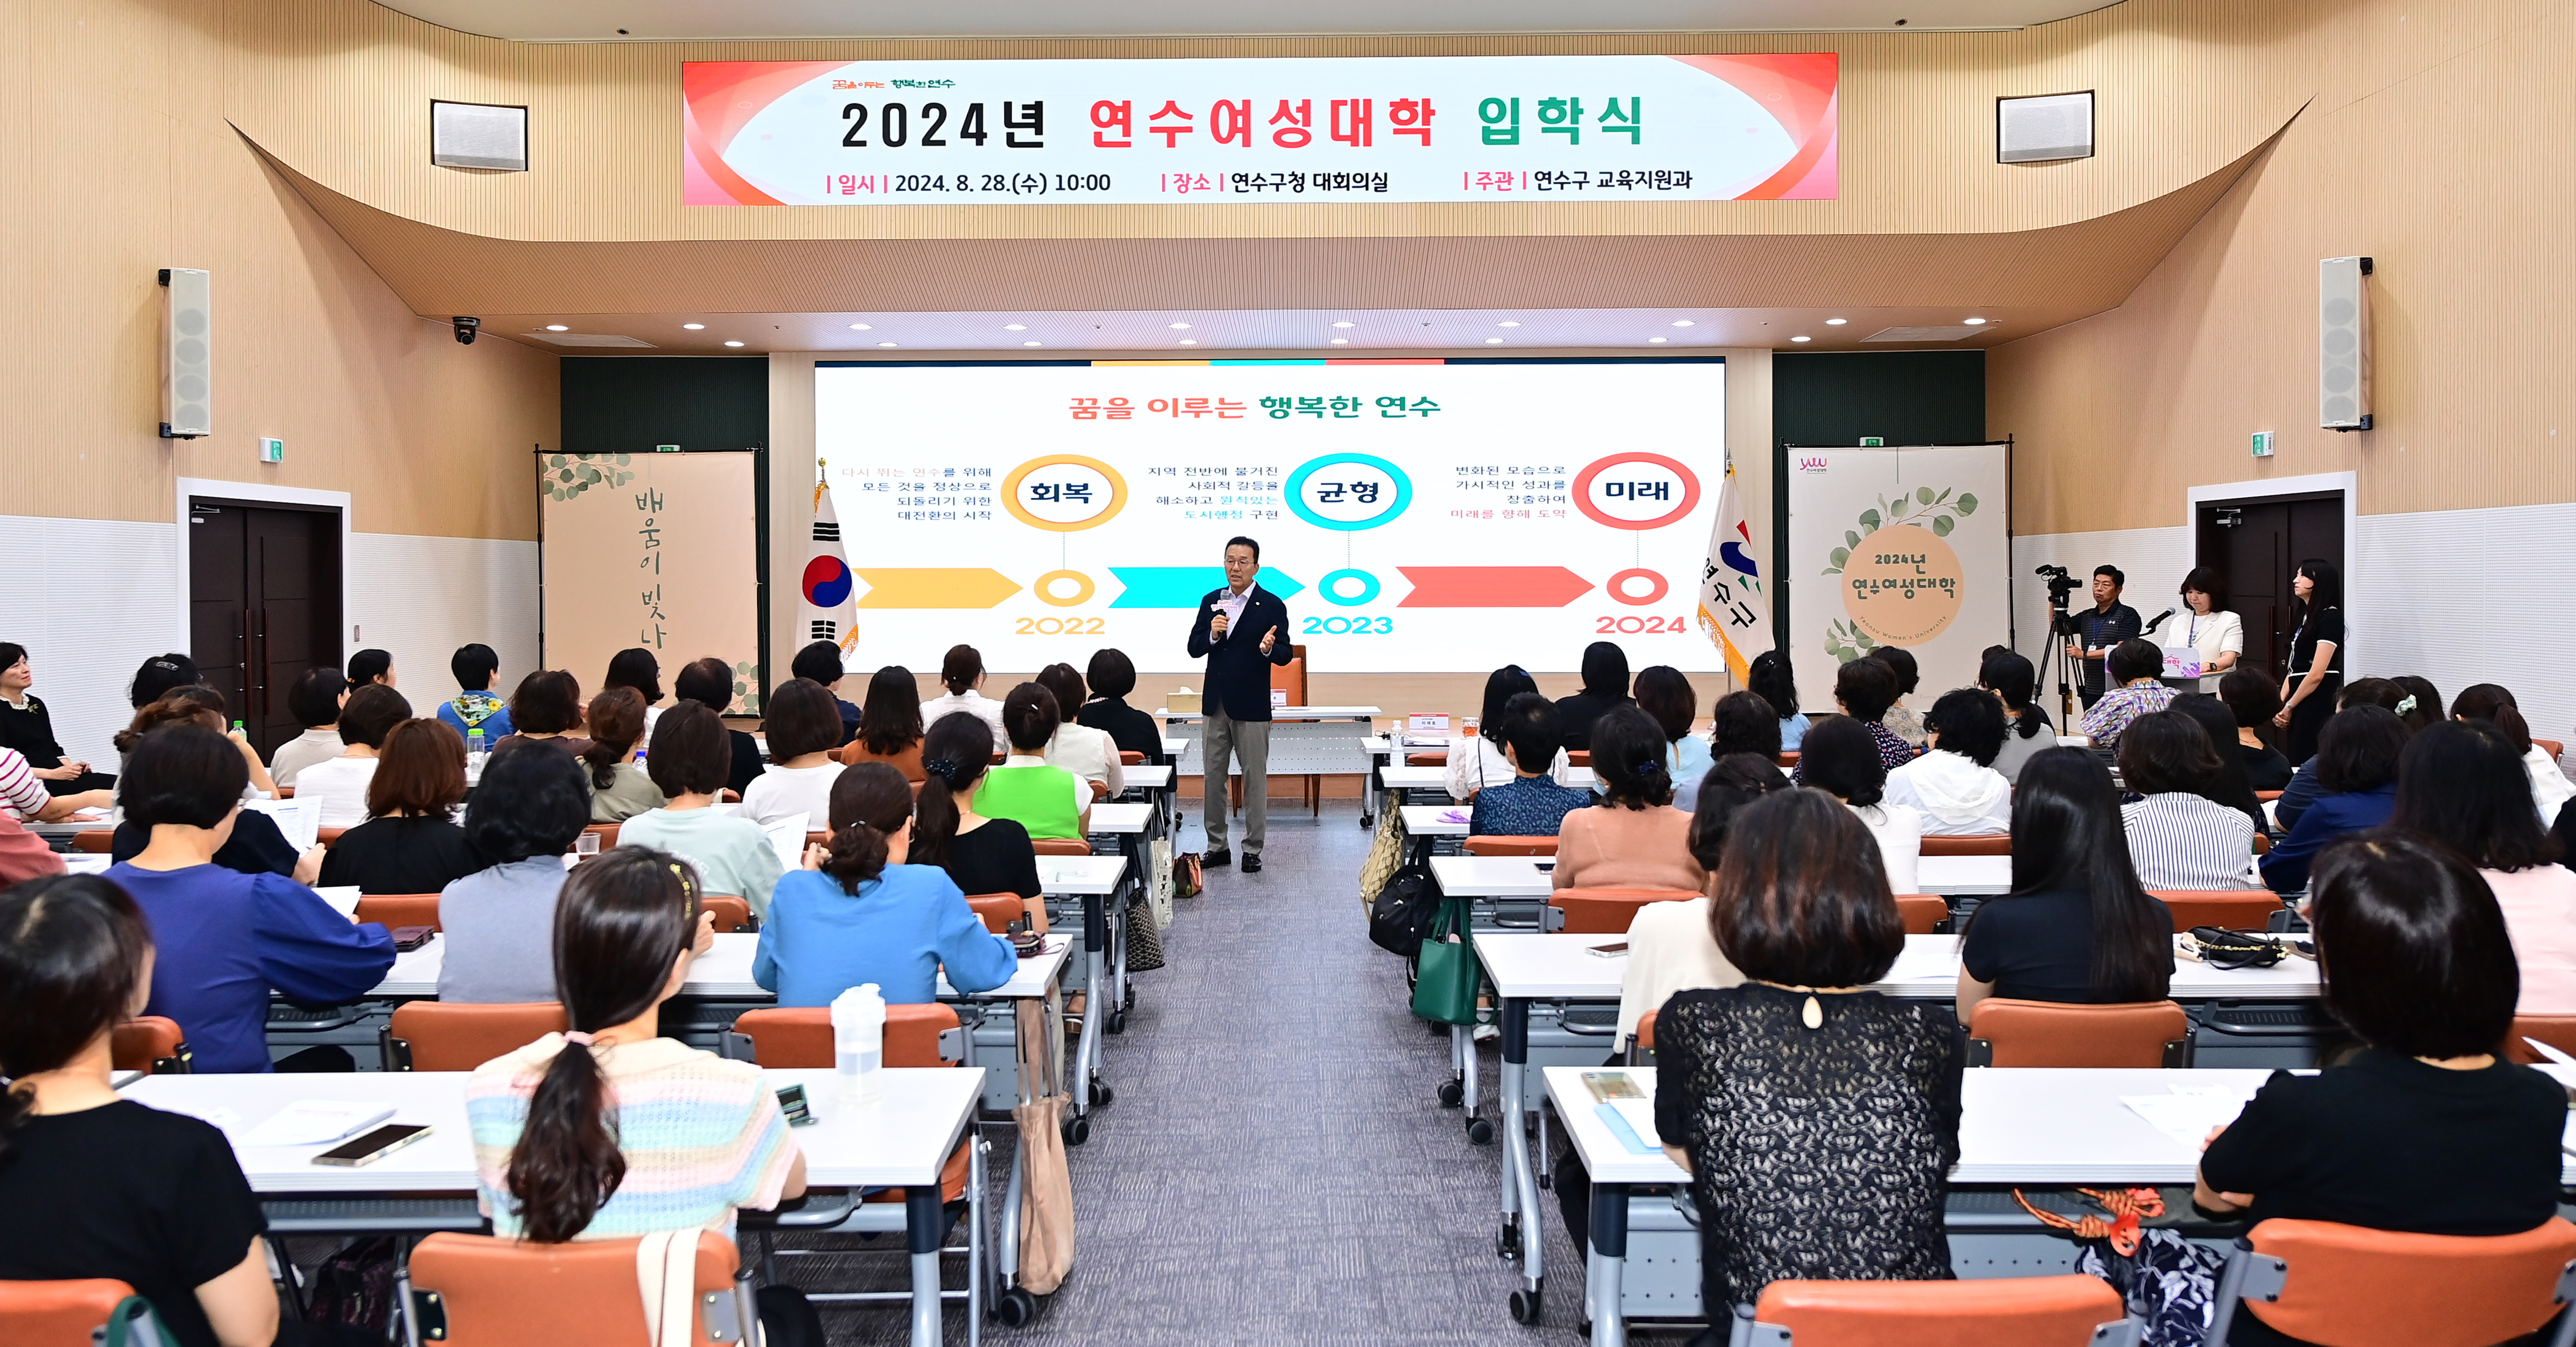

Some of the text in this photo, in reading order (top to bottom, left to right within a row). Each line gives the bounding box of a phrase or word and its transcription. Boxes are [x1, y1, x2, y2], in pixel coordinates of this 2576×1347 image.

[842, 96, 1641, 149] 2024년 연수여성대학 입학식
[838, 172, 1111, 195] 일시 2024. 8. 28.(수) 10:00
[1173, 171, 1388, 194] 장소 연수구청 대회의실
[1475, 169, 1693, 192] 주관 연수구 교육지원과
[1069, 395, 1441, 420] 꿈을 이루는 행복한 연수
[842, 467, 991, 477] 다시 뛰는 연수를 위해
[1148, 467, 1278, 476] 지역 전반에 불거진
[1456, 465, 1566, 476] 변화된 모습으로
[862, 482, 992, 492] 모든 것을 정상으로
[1030, 483, 1093, 504] 회복
[1188, 481, 1279, 491] 사회적 갈등을
[1317, 481, 1378, 504] 균형
[1456, 480, 1566, 490] 가시적인 성과를
[1606, 481, 1669, 501] 미래
[897, 496, 992, 507] 되돌리기 위한
[1156, 495, 1279, 505] 해소하고 원칙있는
[1507, 495, 1566, 504] 창출하여
[898, 511, 992, 520] 대전환의 시작
[1186, 510, 1278, 520] 도시행정 구현
[1451, 509, 1566, 519] 미래를 향해 도약
[1874, 554, 1926, 574] 2024년
[635, 487, 667, 679] 배움이 빛나
[1852, 578, 1956, 599] 연수여성대학
[1016, 617, 1105, 635] 2022
[1302, 616, 1393, 635] 2023
[1596, 616, 1687, 634] 2024
[1859, 615, 1947, 641] Yeonsu Women's University
